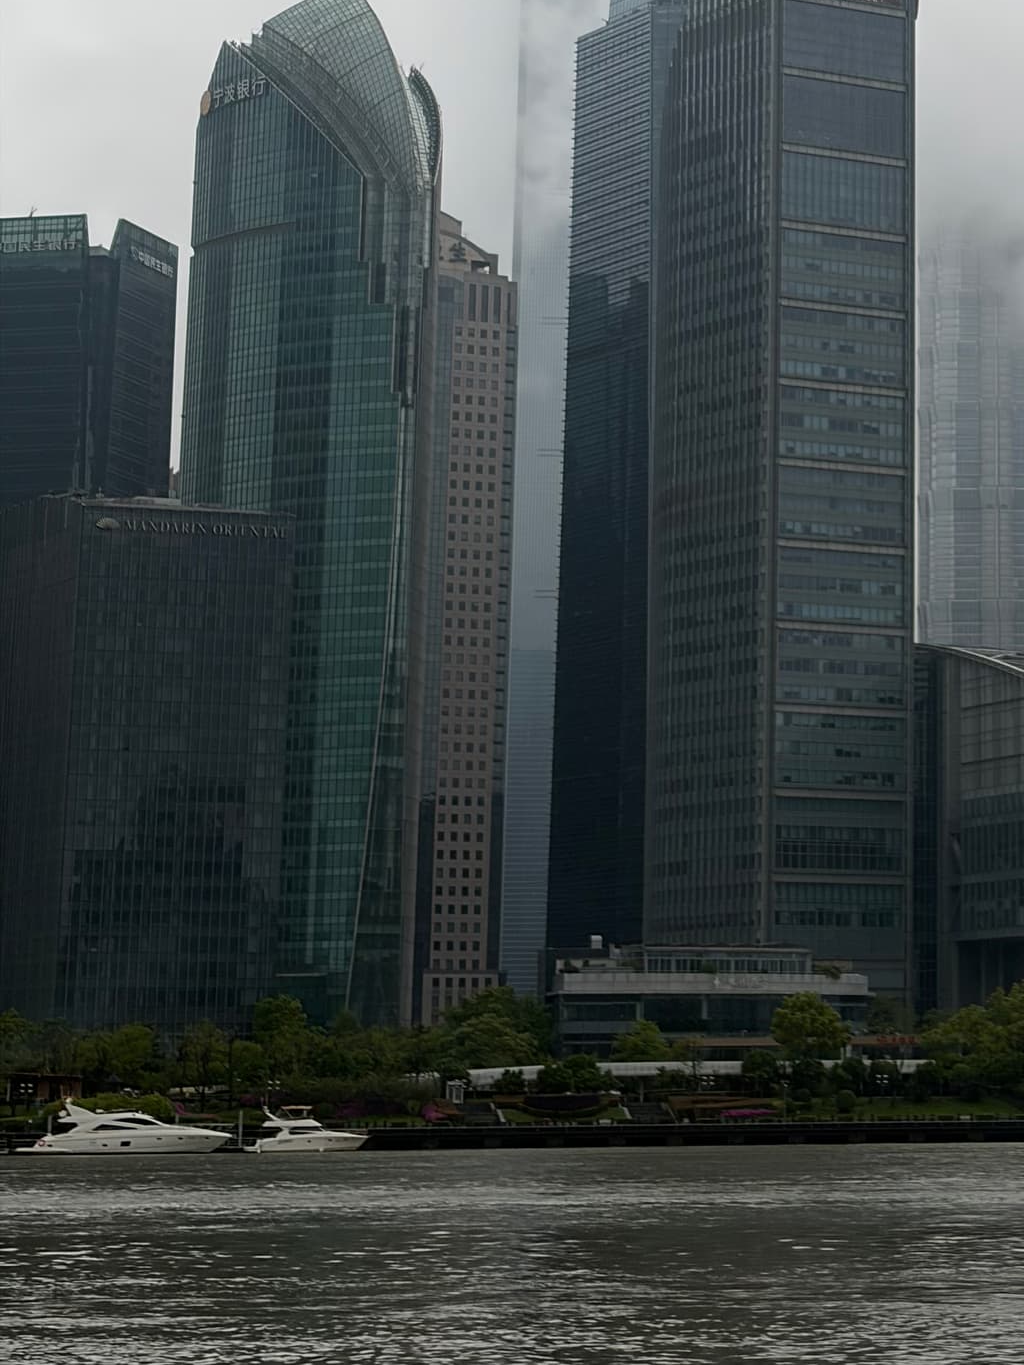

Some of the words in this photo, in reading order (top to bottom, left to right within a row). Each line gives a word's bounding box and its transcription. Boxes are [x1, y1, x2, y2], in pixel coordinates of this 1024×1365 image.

[213, 76, 266, 109] 宁波银行
[0, 239, 77, 253] 国民生银行
[125, 519, 208, 535] MANDARIN
[212, 525, 287, 539] ORIENTAL
